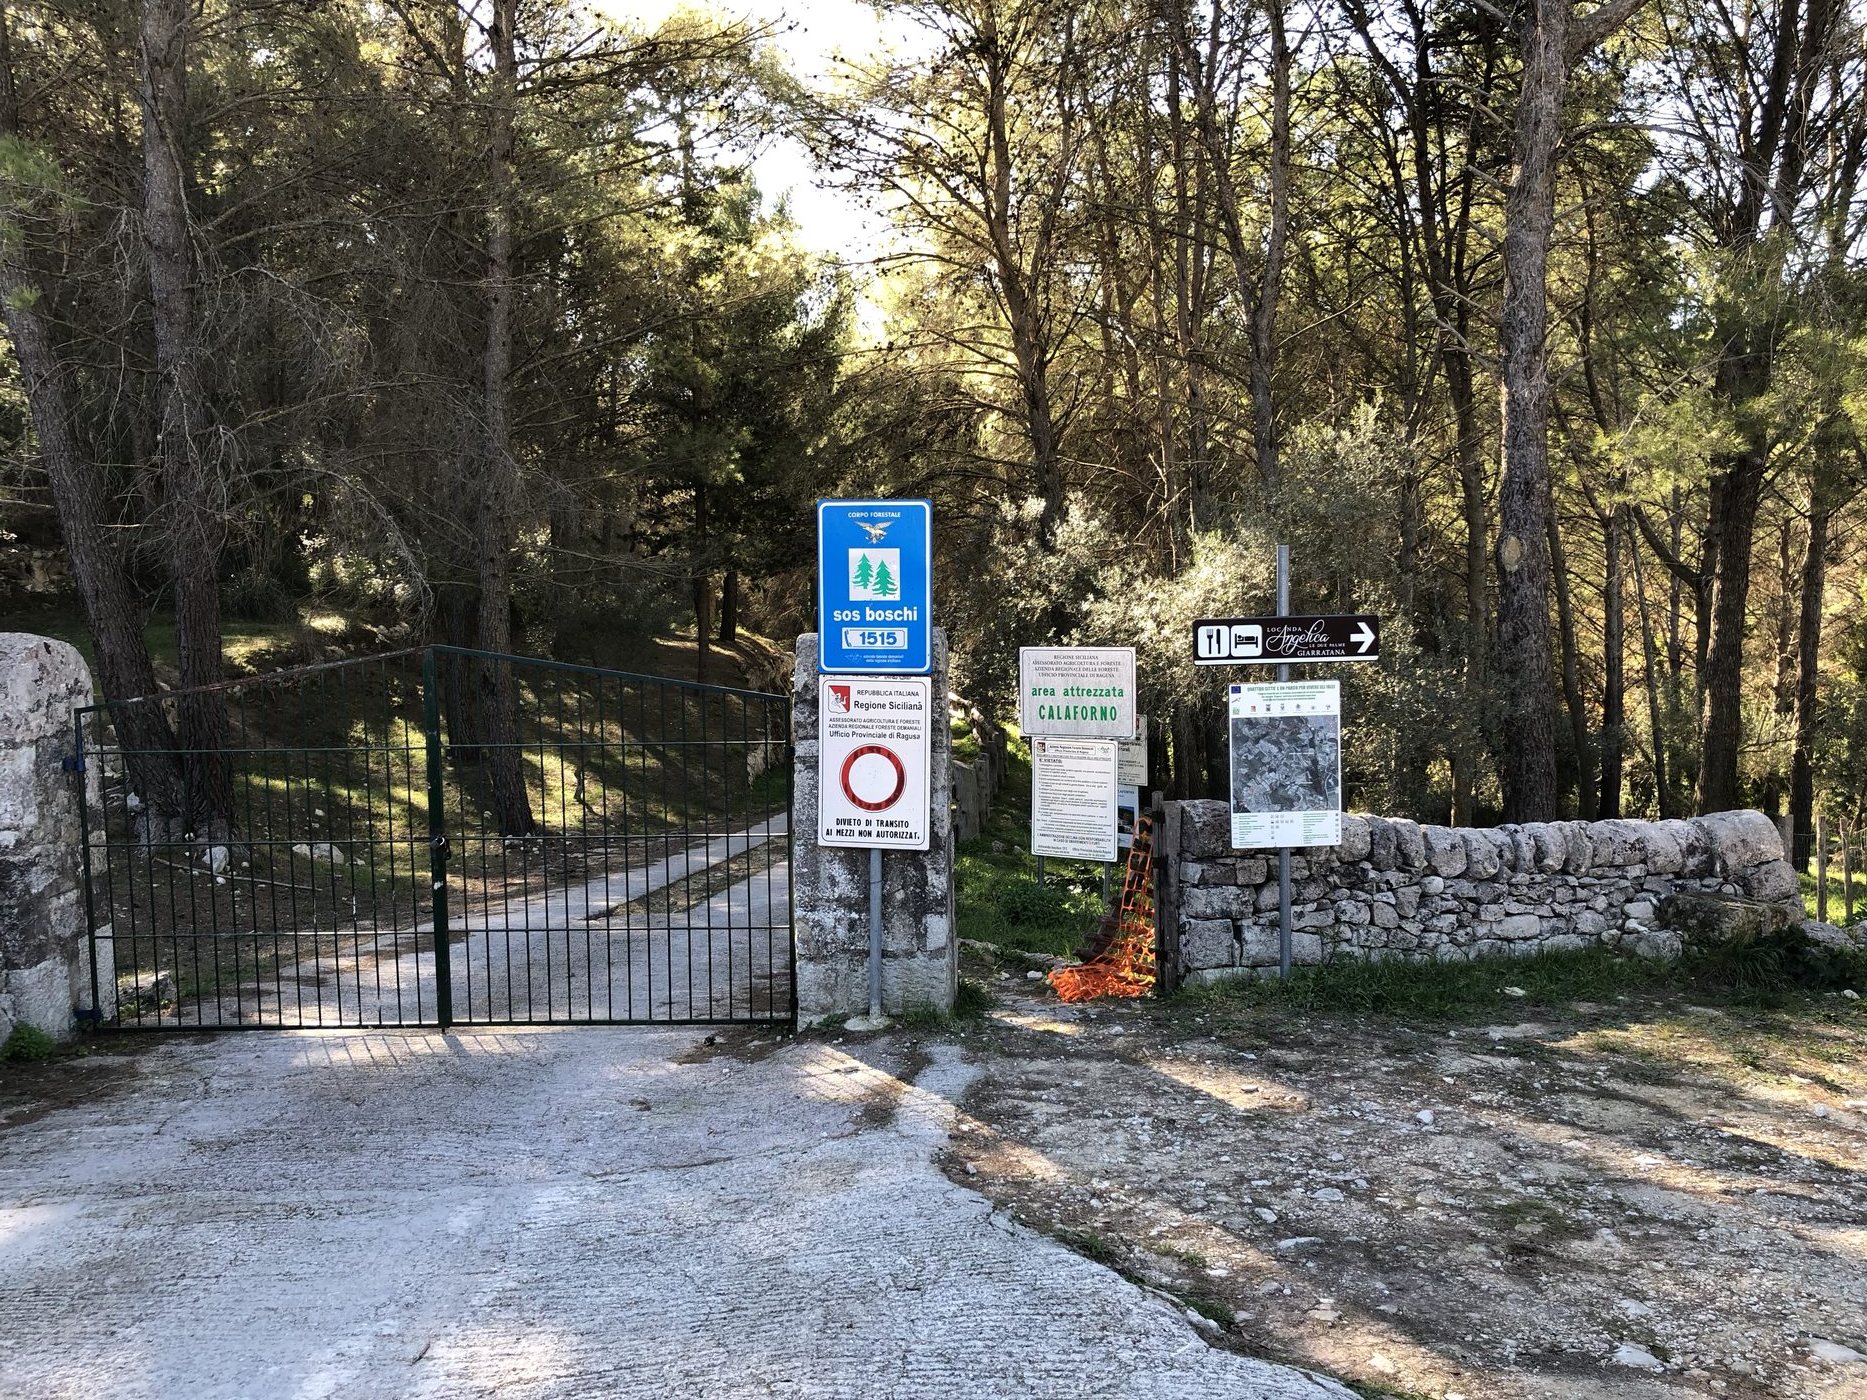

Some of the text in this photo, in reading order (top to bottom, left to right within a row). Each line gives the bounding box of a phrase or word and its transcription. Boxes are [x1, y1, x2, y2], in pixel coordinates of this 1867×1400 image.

[833, 606, 918, 621] sos boschi
[860, 632, 898, 645] 1515
[1266, 619, 1330, 656] Angelica
[1032, 686, 1124, 697] area attrezzata
[854, 701, 886, 711] Regione
[1038, 705, 1117, 720] CALAFORNO
[896, 732, 920, 741] Ragusa
[836, 818, 861, 826] DIVIETO
[876, 820, 909, 828] TRANSITO
